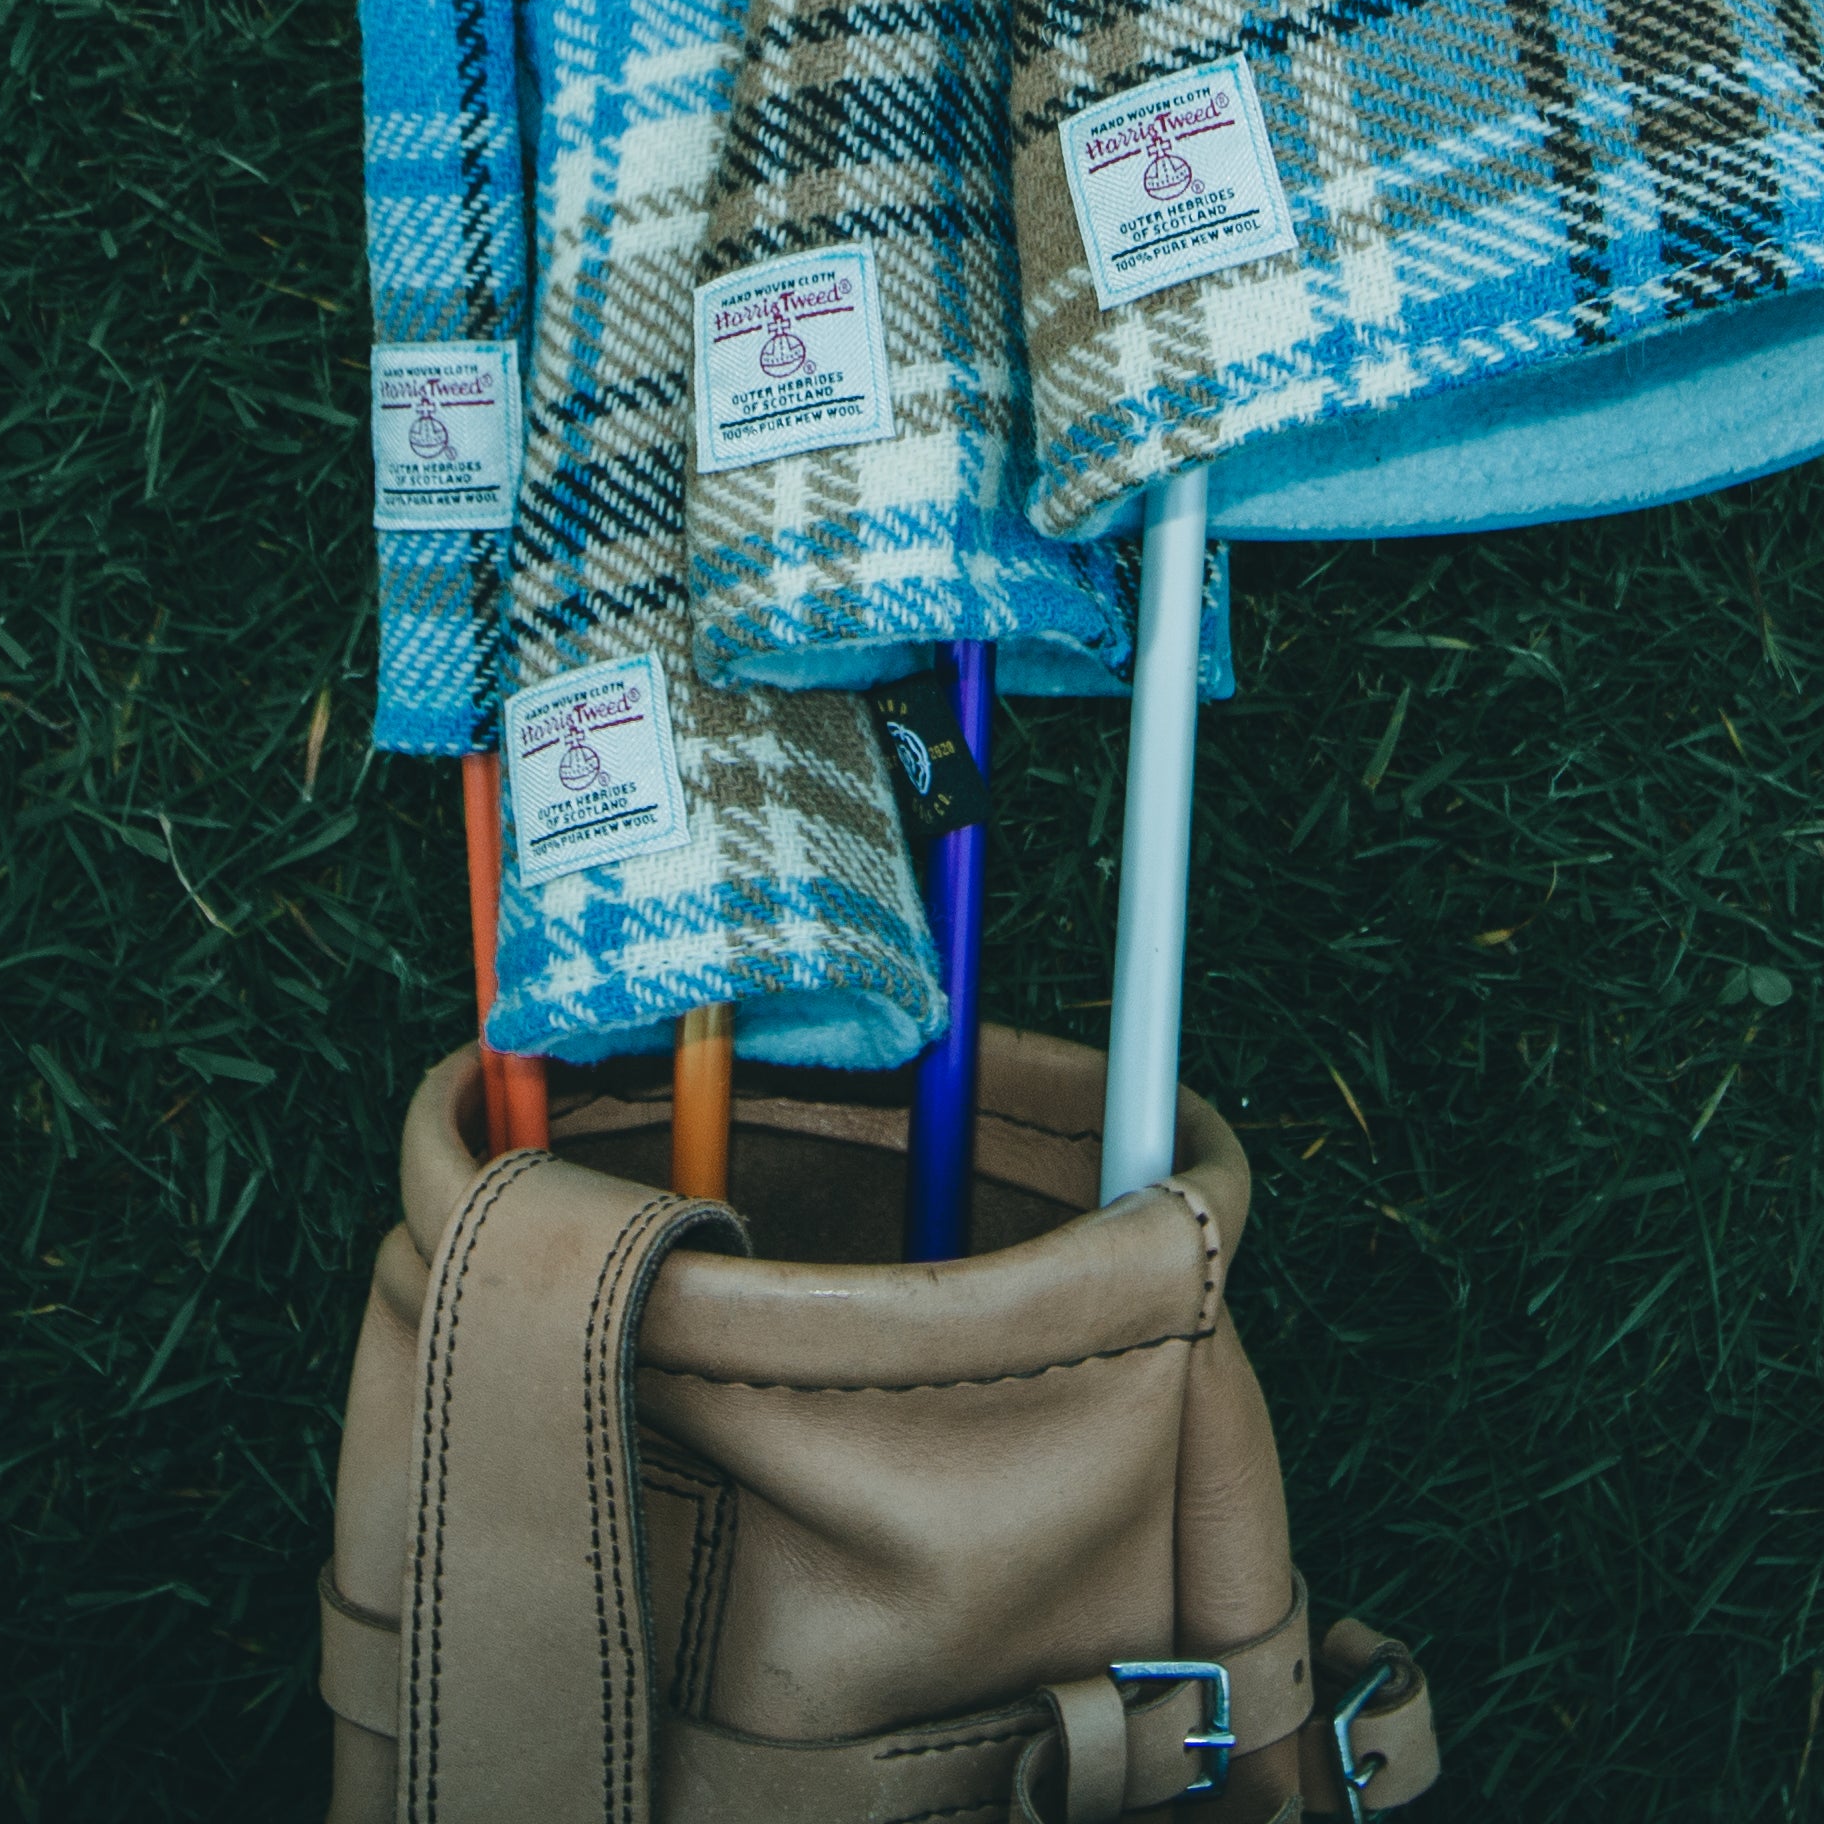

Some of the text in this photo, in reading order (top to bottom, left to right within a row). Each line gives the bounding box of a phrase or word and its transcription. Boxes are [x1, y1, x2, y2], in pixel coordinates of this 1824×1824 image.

[1091, 87, 1211, 136] HAND WOVEN CLOTH
[1120, 187, 1235, 234] OUTER HEBRIDES
[1133, 204, 1227, 242] OF SCOTLAND
[1116, 218, 1261, 273] 100% PURE NEW WOOL
[721, 271, 836, 308] HAND WOVEN CLOTH
[732, 371, 844, 406] OUTER HEBRIDES
[743, 386, 834, 415] OF SCOTLAND
[722, 405, 863, 441] 100% PURE NEW WOOL
[526, 681, 625, 721] HAND WOVEN CLOTH
[538, 782, 637, 820] OUTER HEBRIDES
[546, 798, 628, 828] OF SCOTLAND
[532, 814, 658, 857] 100% PURE NEW WOOL
